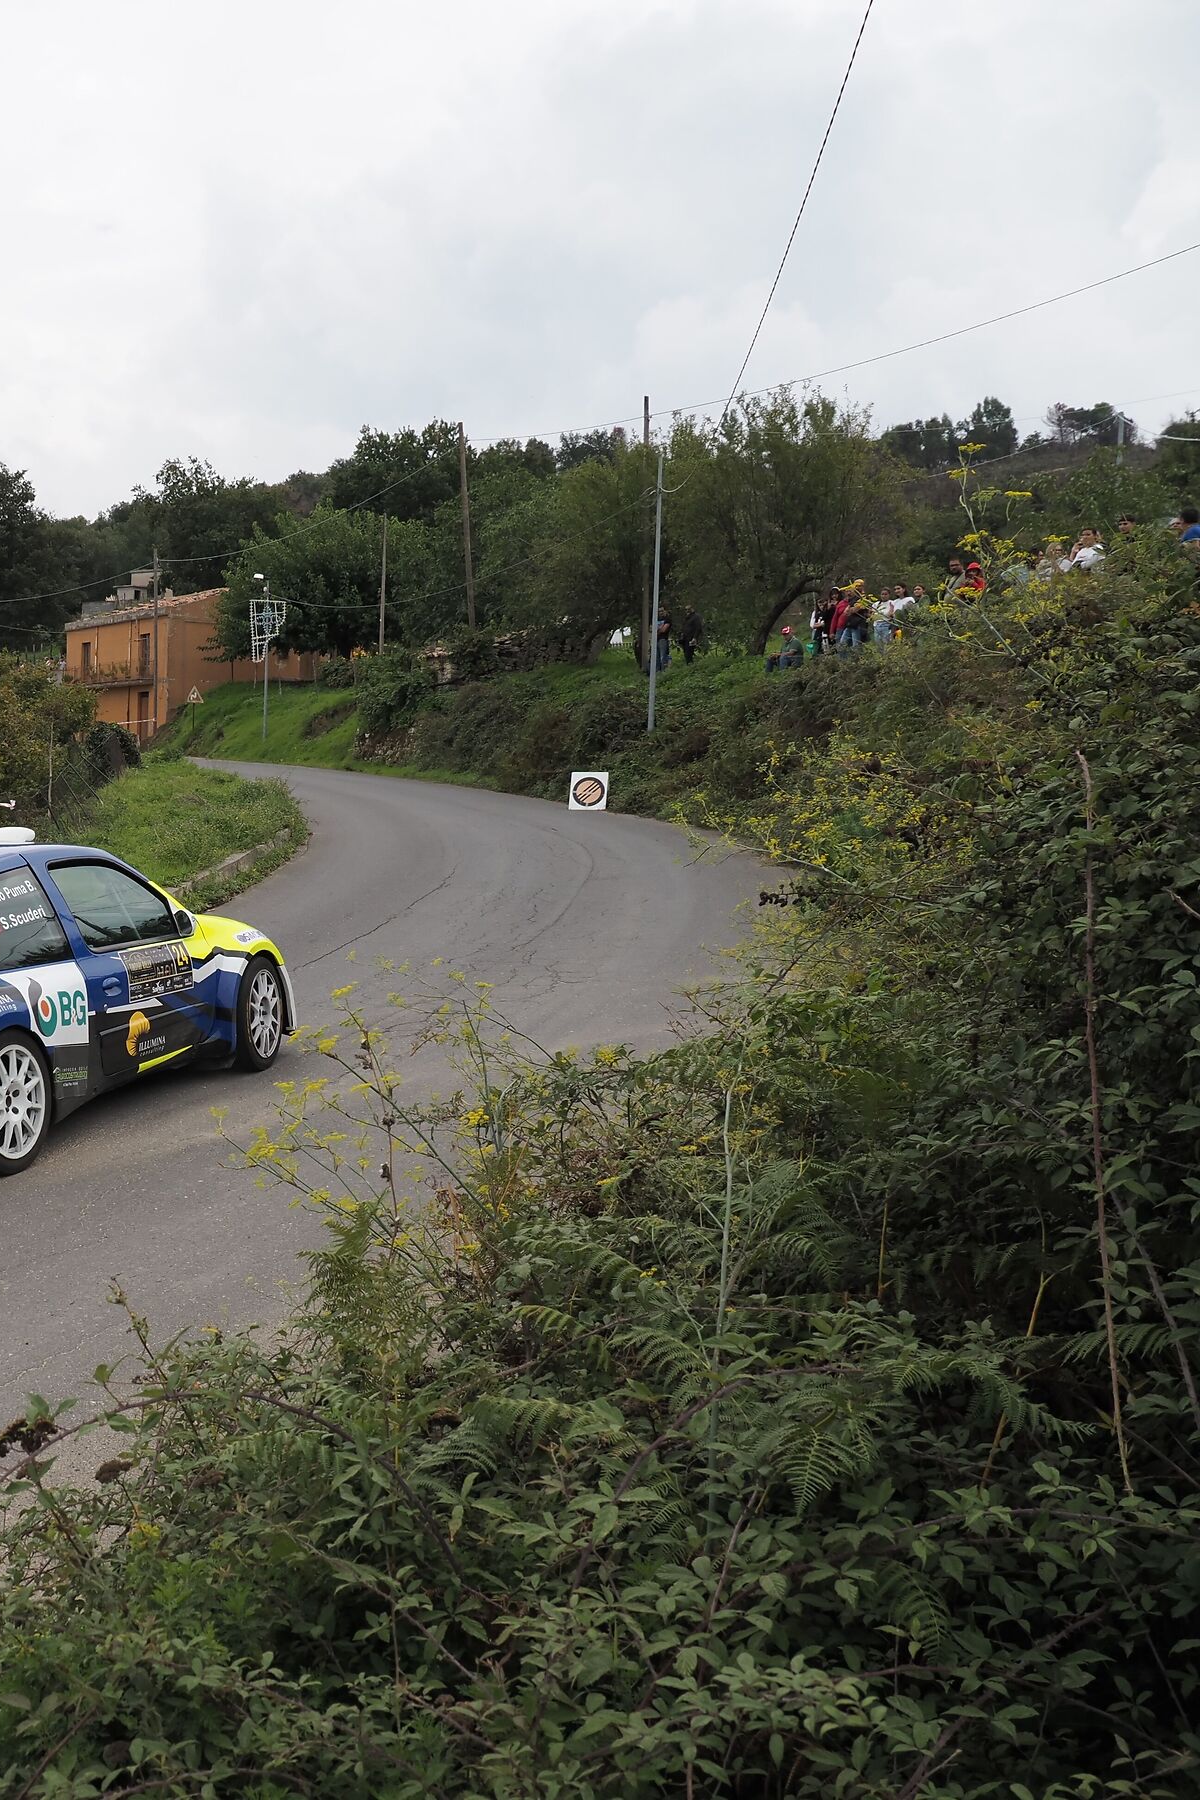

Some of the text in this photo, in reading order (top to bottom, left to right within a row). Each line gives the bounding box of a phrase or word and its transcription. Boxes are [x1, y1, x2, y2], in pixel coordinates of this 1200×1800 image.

[3, 883, 28, 899] Puma
[24, 880, 38, 892] B.
[0, 905, 47, 930] S.Scuderi
[171, 944, 189, 967] 24
[57, 989, 87, 1027] B&G
